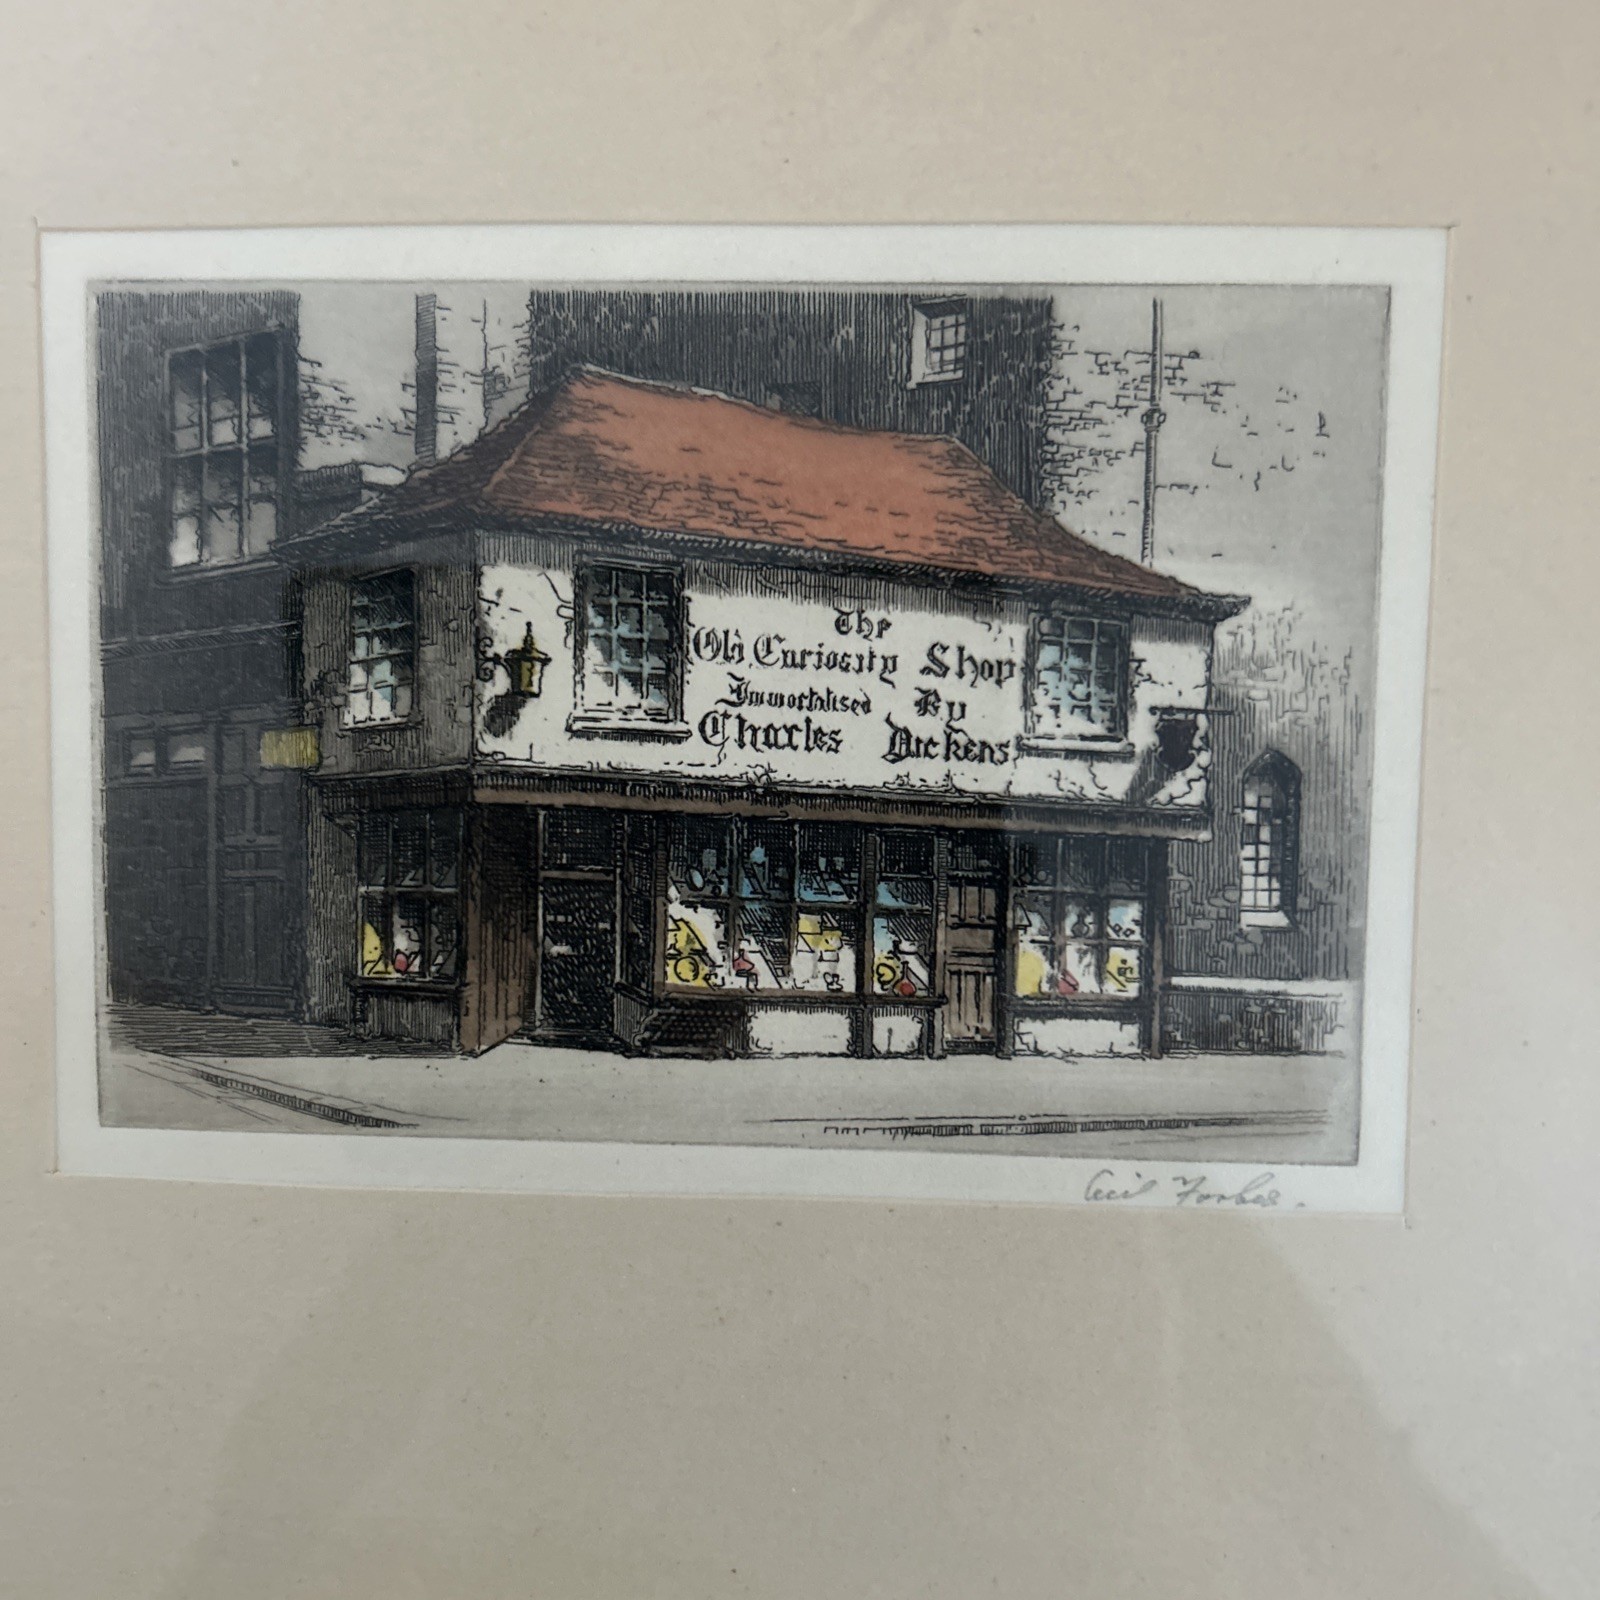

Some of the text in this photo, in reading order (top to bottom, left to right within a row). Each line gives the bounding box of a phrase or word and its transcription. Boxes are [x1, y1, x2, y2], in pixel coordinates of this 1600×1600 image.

[834, 608, 892, 641] The
[693, 626, 1017, 688] Old Curiosity Shop
[715, 672, 967, 733] Immortalised By
[698, 710, 1011, 765] Charles Dickens
